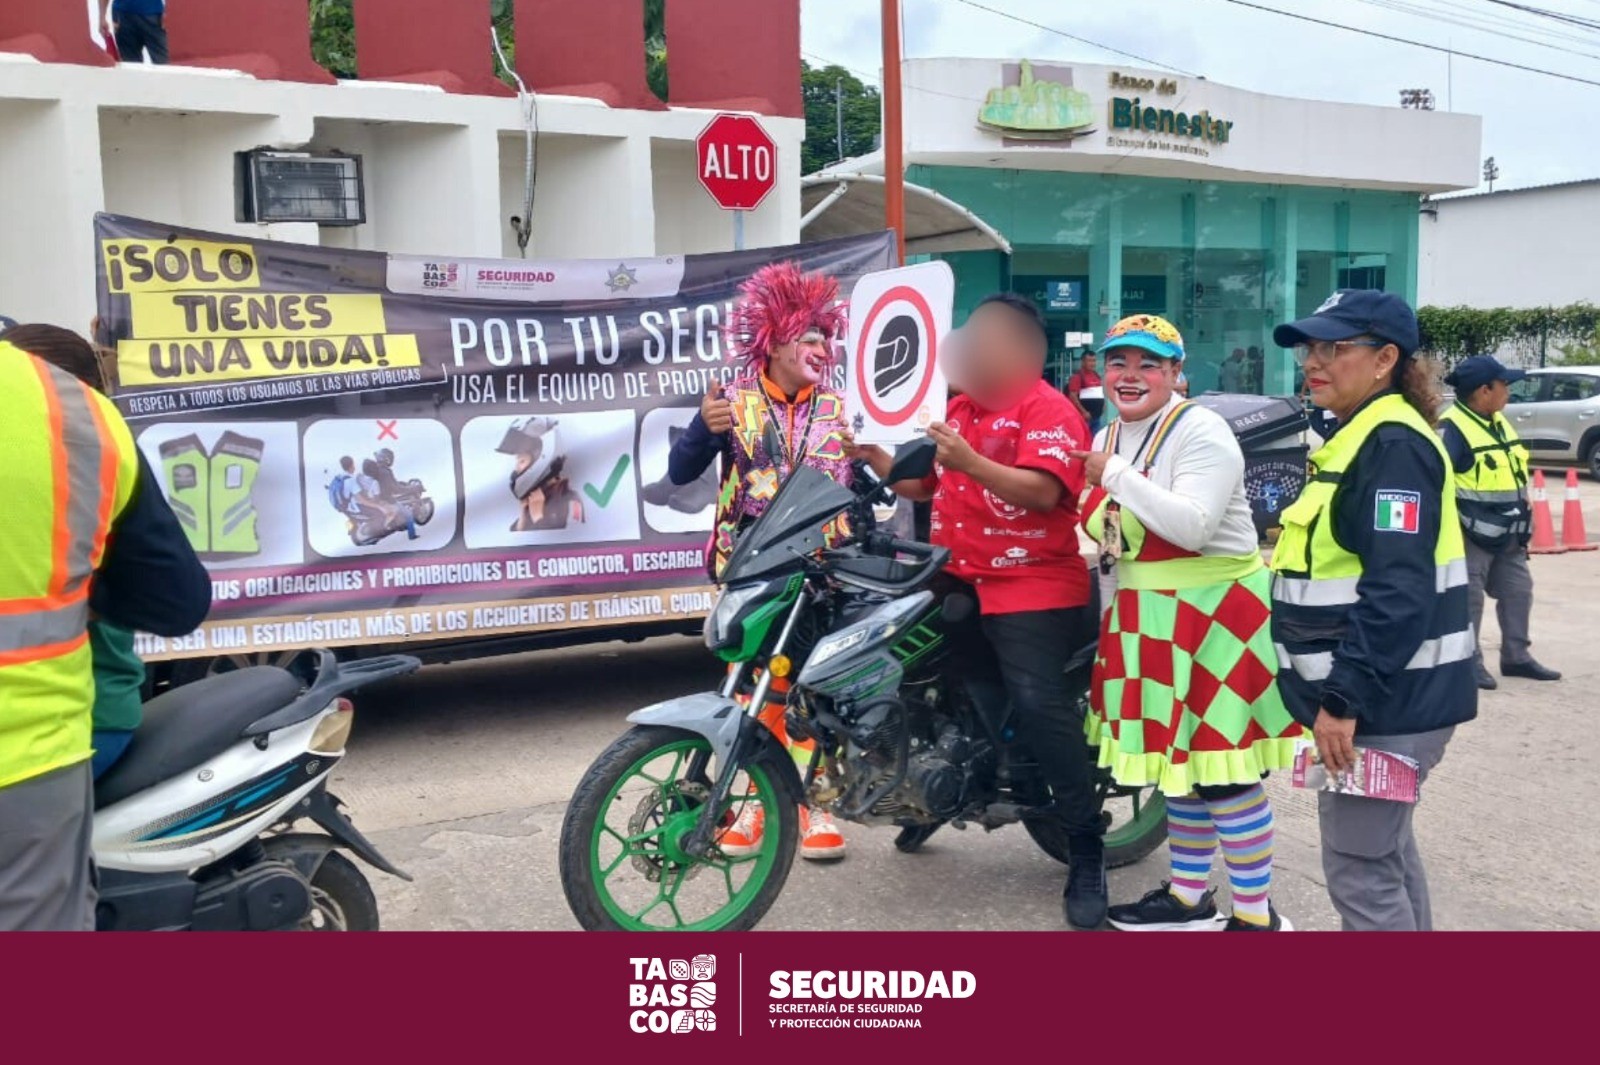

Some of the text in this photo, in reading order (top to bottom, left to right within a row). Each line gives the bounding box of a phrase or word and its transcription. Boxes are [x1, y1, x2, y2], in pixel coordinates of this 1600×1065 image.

[1108, 97, 1233, 145] Bienestar
[703, 142, 770, 181] ALTO
[106, 234, 253, 290] ¡SÓLO
[477, 270, 555, 283] SEGURIDAD
[173, 295, 332, 332] TIENES
[149, 334, 390, 379] UNA VIDA!
[450, 316, 547, 367] POR
[563, 313, 621, 366] TU
[129, 392, 176, 413] RESPETA
[179, 391, 188, 407] A
[190, 389, 223, 406] TODOS
[226, 386, 246, 402] LOS
[249, 377, 302, 399] USUARIOS
[306, 376, 319, 393] DE
[322, 374, 341, 391] LAS
[372, 367, 421, 386] PÚBLICAS
[452, 374, 496, 404] USA
[506, 373, 529, 403] EL
[537, 370, 614, 402] EQUIPO
[625, 372, 650, 399] DE
[1234, 411, 1268, 428] RACE
[211, 550, 703, 601] TUS OBLIGACIONES Y PROHIBICIONES DEL CONDUCTOR, DESCARGA
[172, 628, 205, 651] SER
[211, 625, 247, 648] UNA
[252, 615, 362, 645] ESTADÍSTICA
[366, 611, 406, 637] MÁS
[411, 613, 432, 634] DE
[437, 610, 468, 631] LOS
[472, 601, 567, 629] ACCIDENTES
[570, 600, 589, 621] DE
[594, 594, 667, 620] TRÁNSITO,
[670, 591, 713, 615] CUIDA
